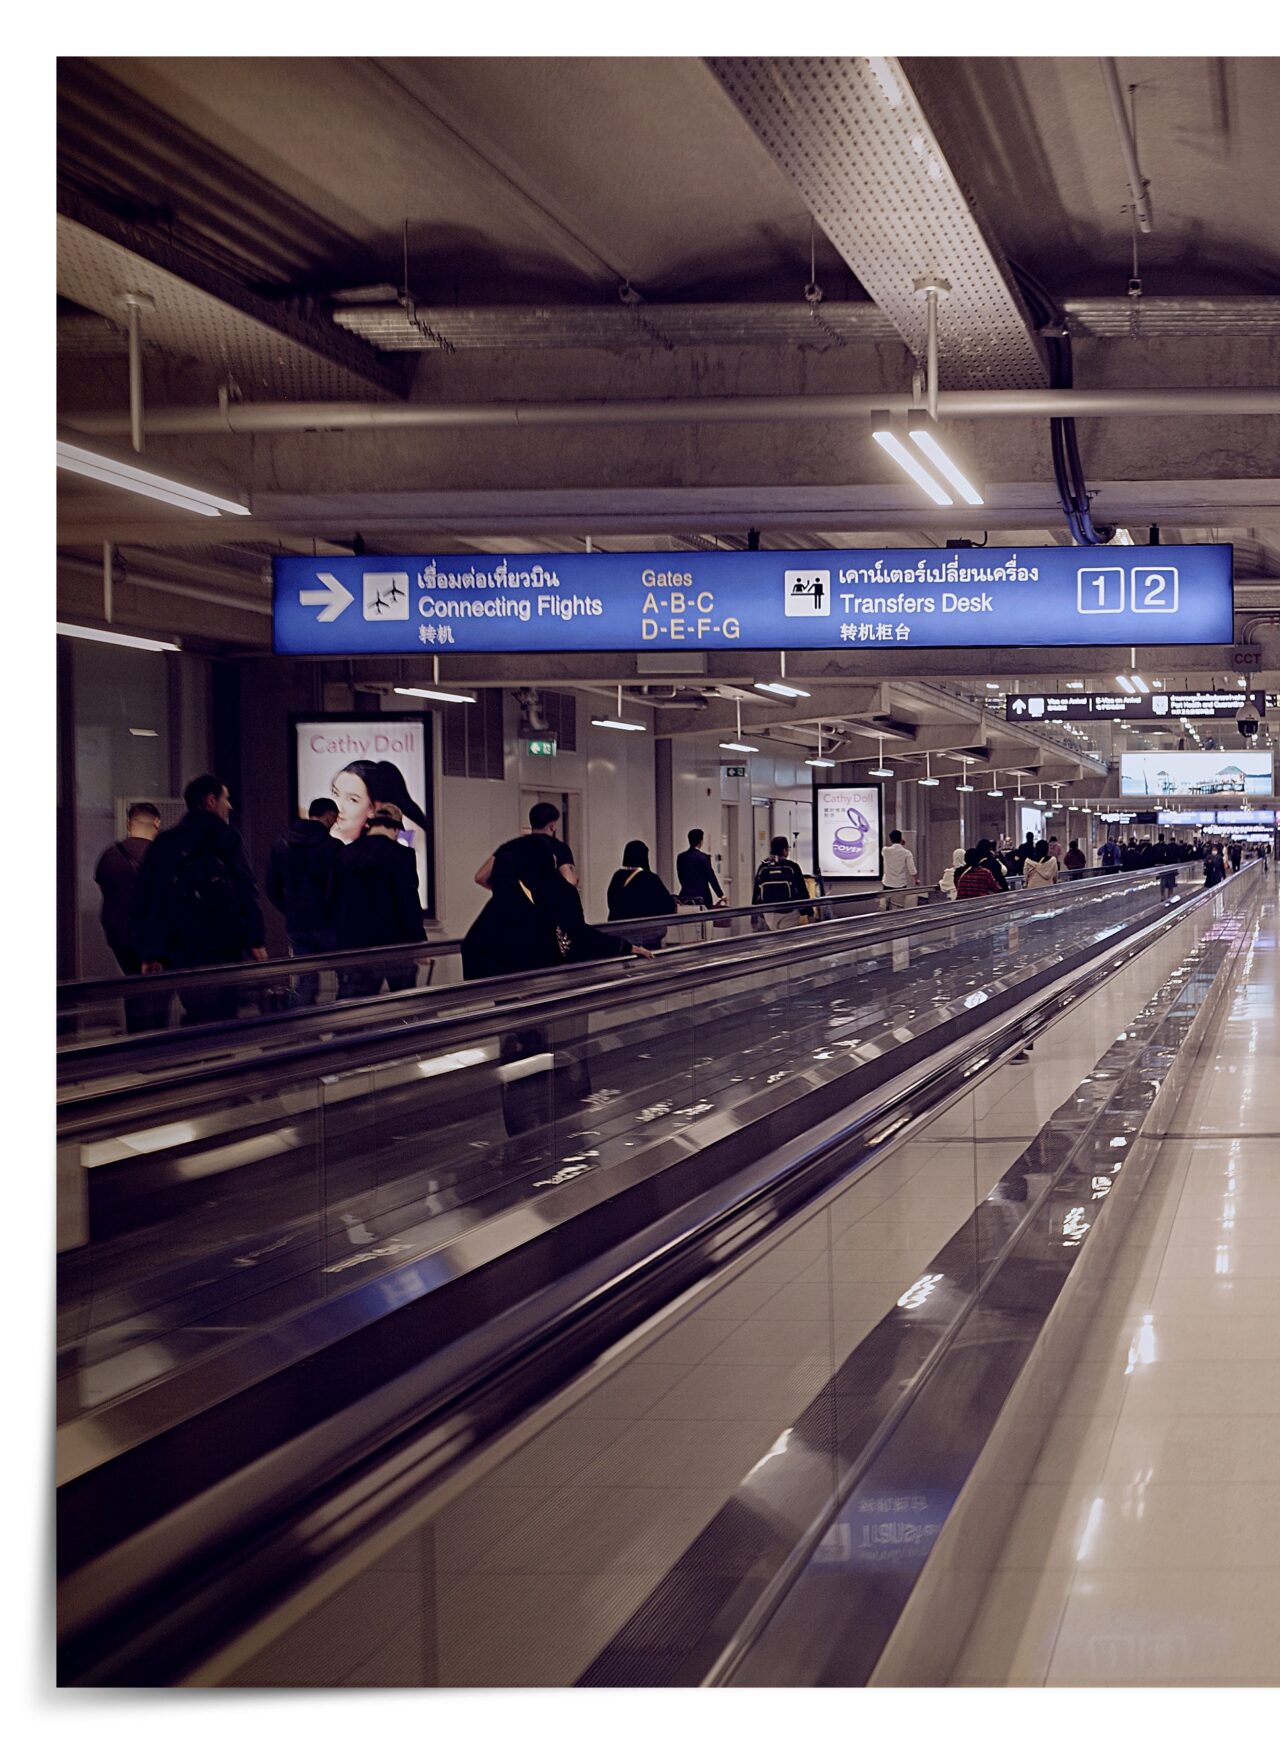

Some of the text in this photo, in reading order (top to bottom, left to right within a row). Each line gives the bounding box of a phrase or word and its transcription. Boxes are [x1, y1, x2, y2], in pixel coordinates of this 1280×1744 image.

[417, 558, 560, 589] เชื่อมต่อเที่ยวบิน
[641, 569, 693, 588] Gates
[839, 554, 1039, 583] เคาน์เตอร์เปลี่ยนเครื่อง
[1092, 574, 1166, 606] 1 2
[418, 595, 603, 621] Connecting Flights
[642, 591, 714, 614] A-B-C
[840, 592, 993, 613] Transfers Desk
[418, 624, 455, 644] 转机
[641, 618, 740, 640] D-E-F-G
[840, 623, 911, 641] 转机柜台
[310, 733, 415, 759] Cathy Doll
[824, 793, 873, 805] Cathy Doll
